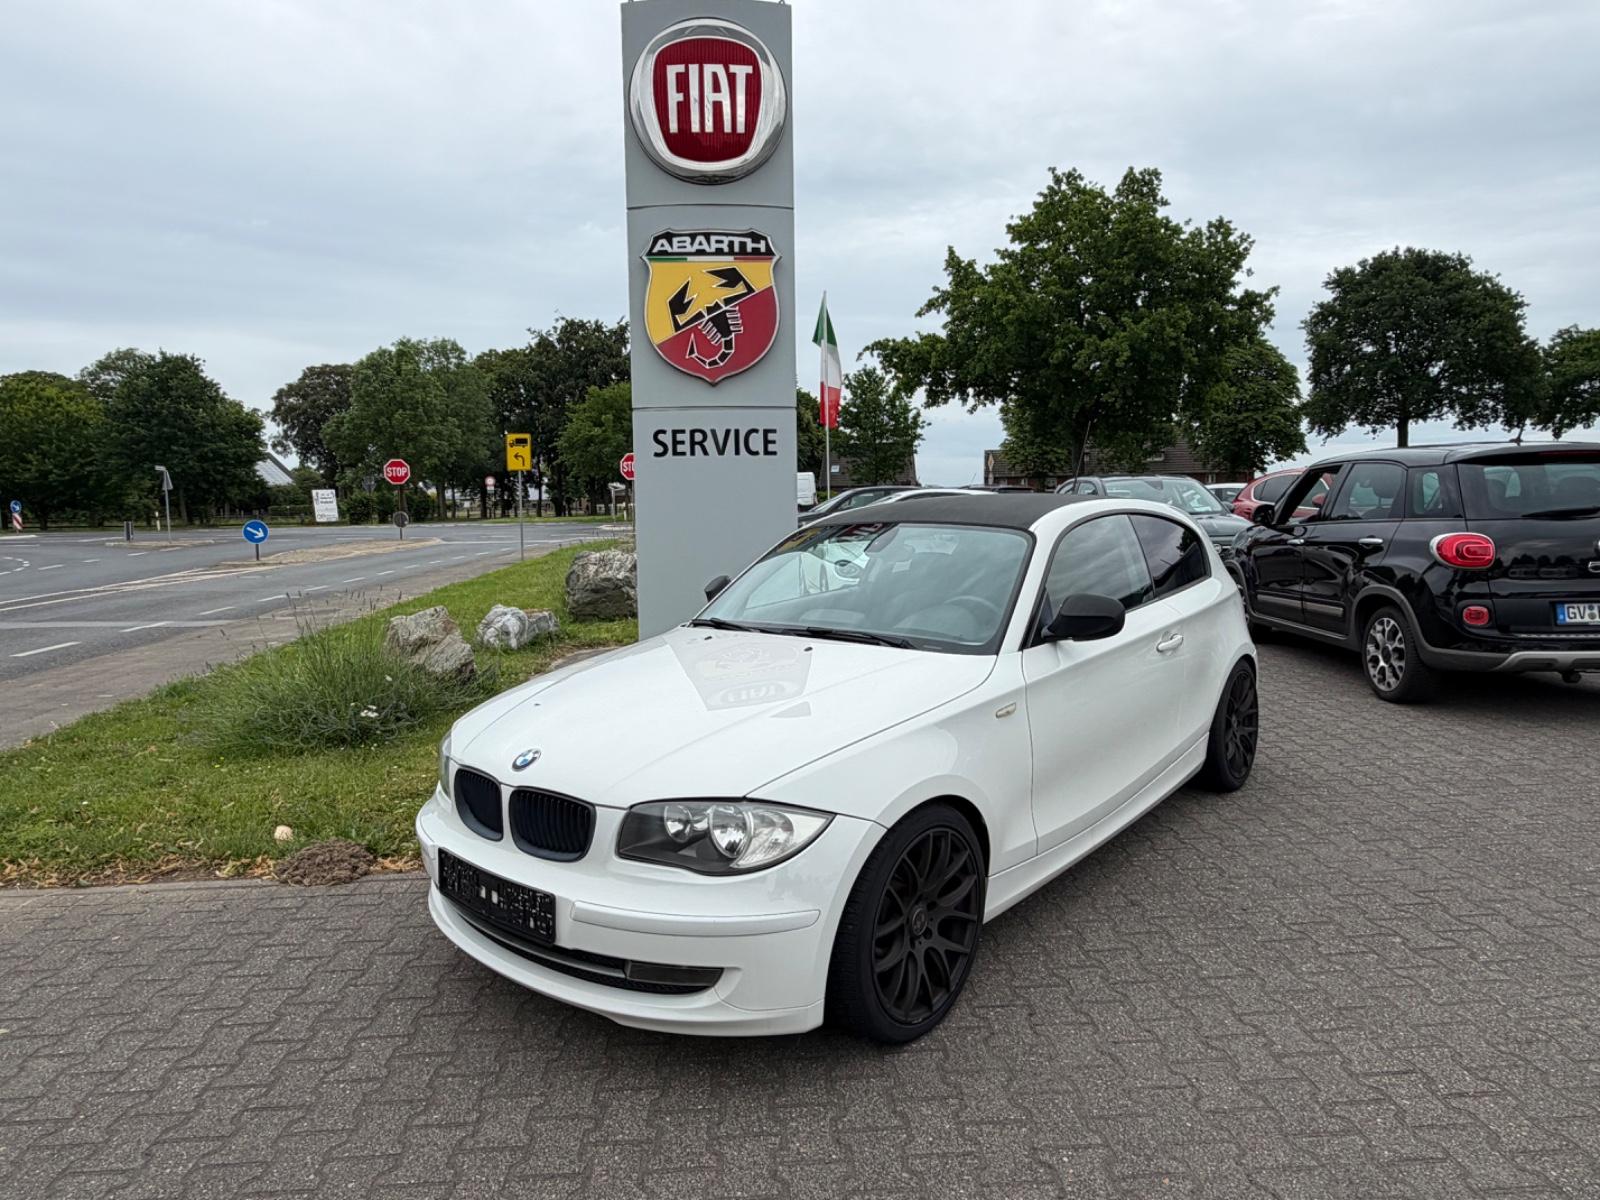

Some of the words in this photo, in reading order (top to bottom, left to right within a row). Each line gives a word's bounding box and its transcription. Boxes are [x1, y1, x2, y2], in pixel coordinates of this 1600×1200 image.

[666, 63, 753, 134] FIAT
[651, 235, 766, 254] ABARTH
[652, 428, 778, 458] SERVICE
[387, 466, 407, 477] STOP
[623, 461, 634, 472] ST
